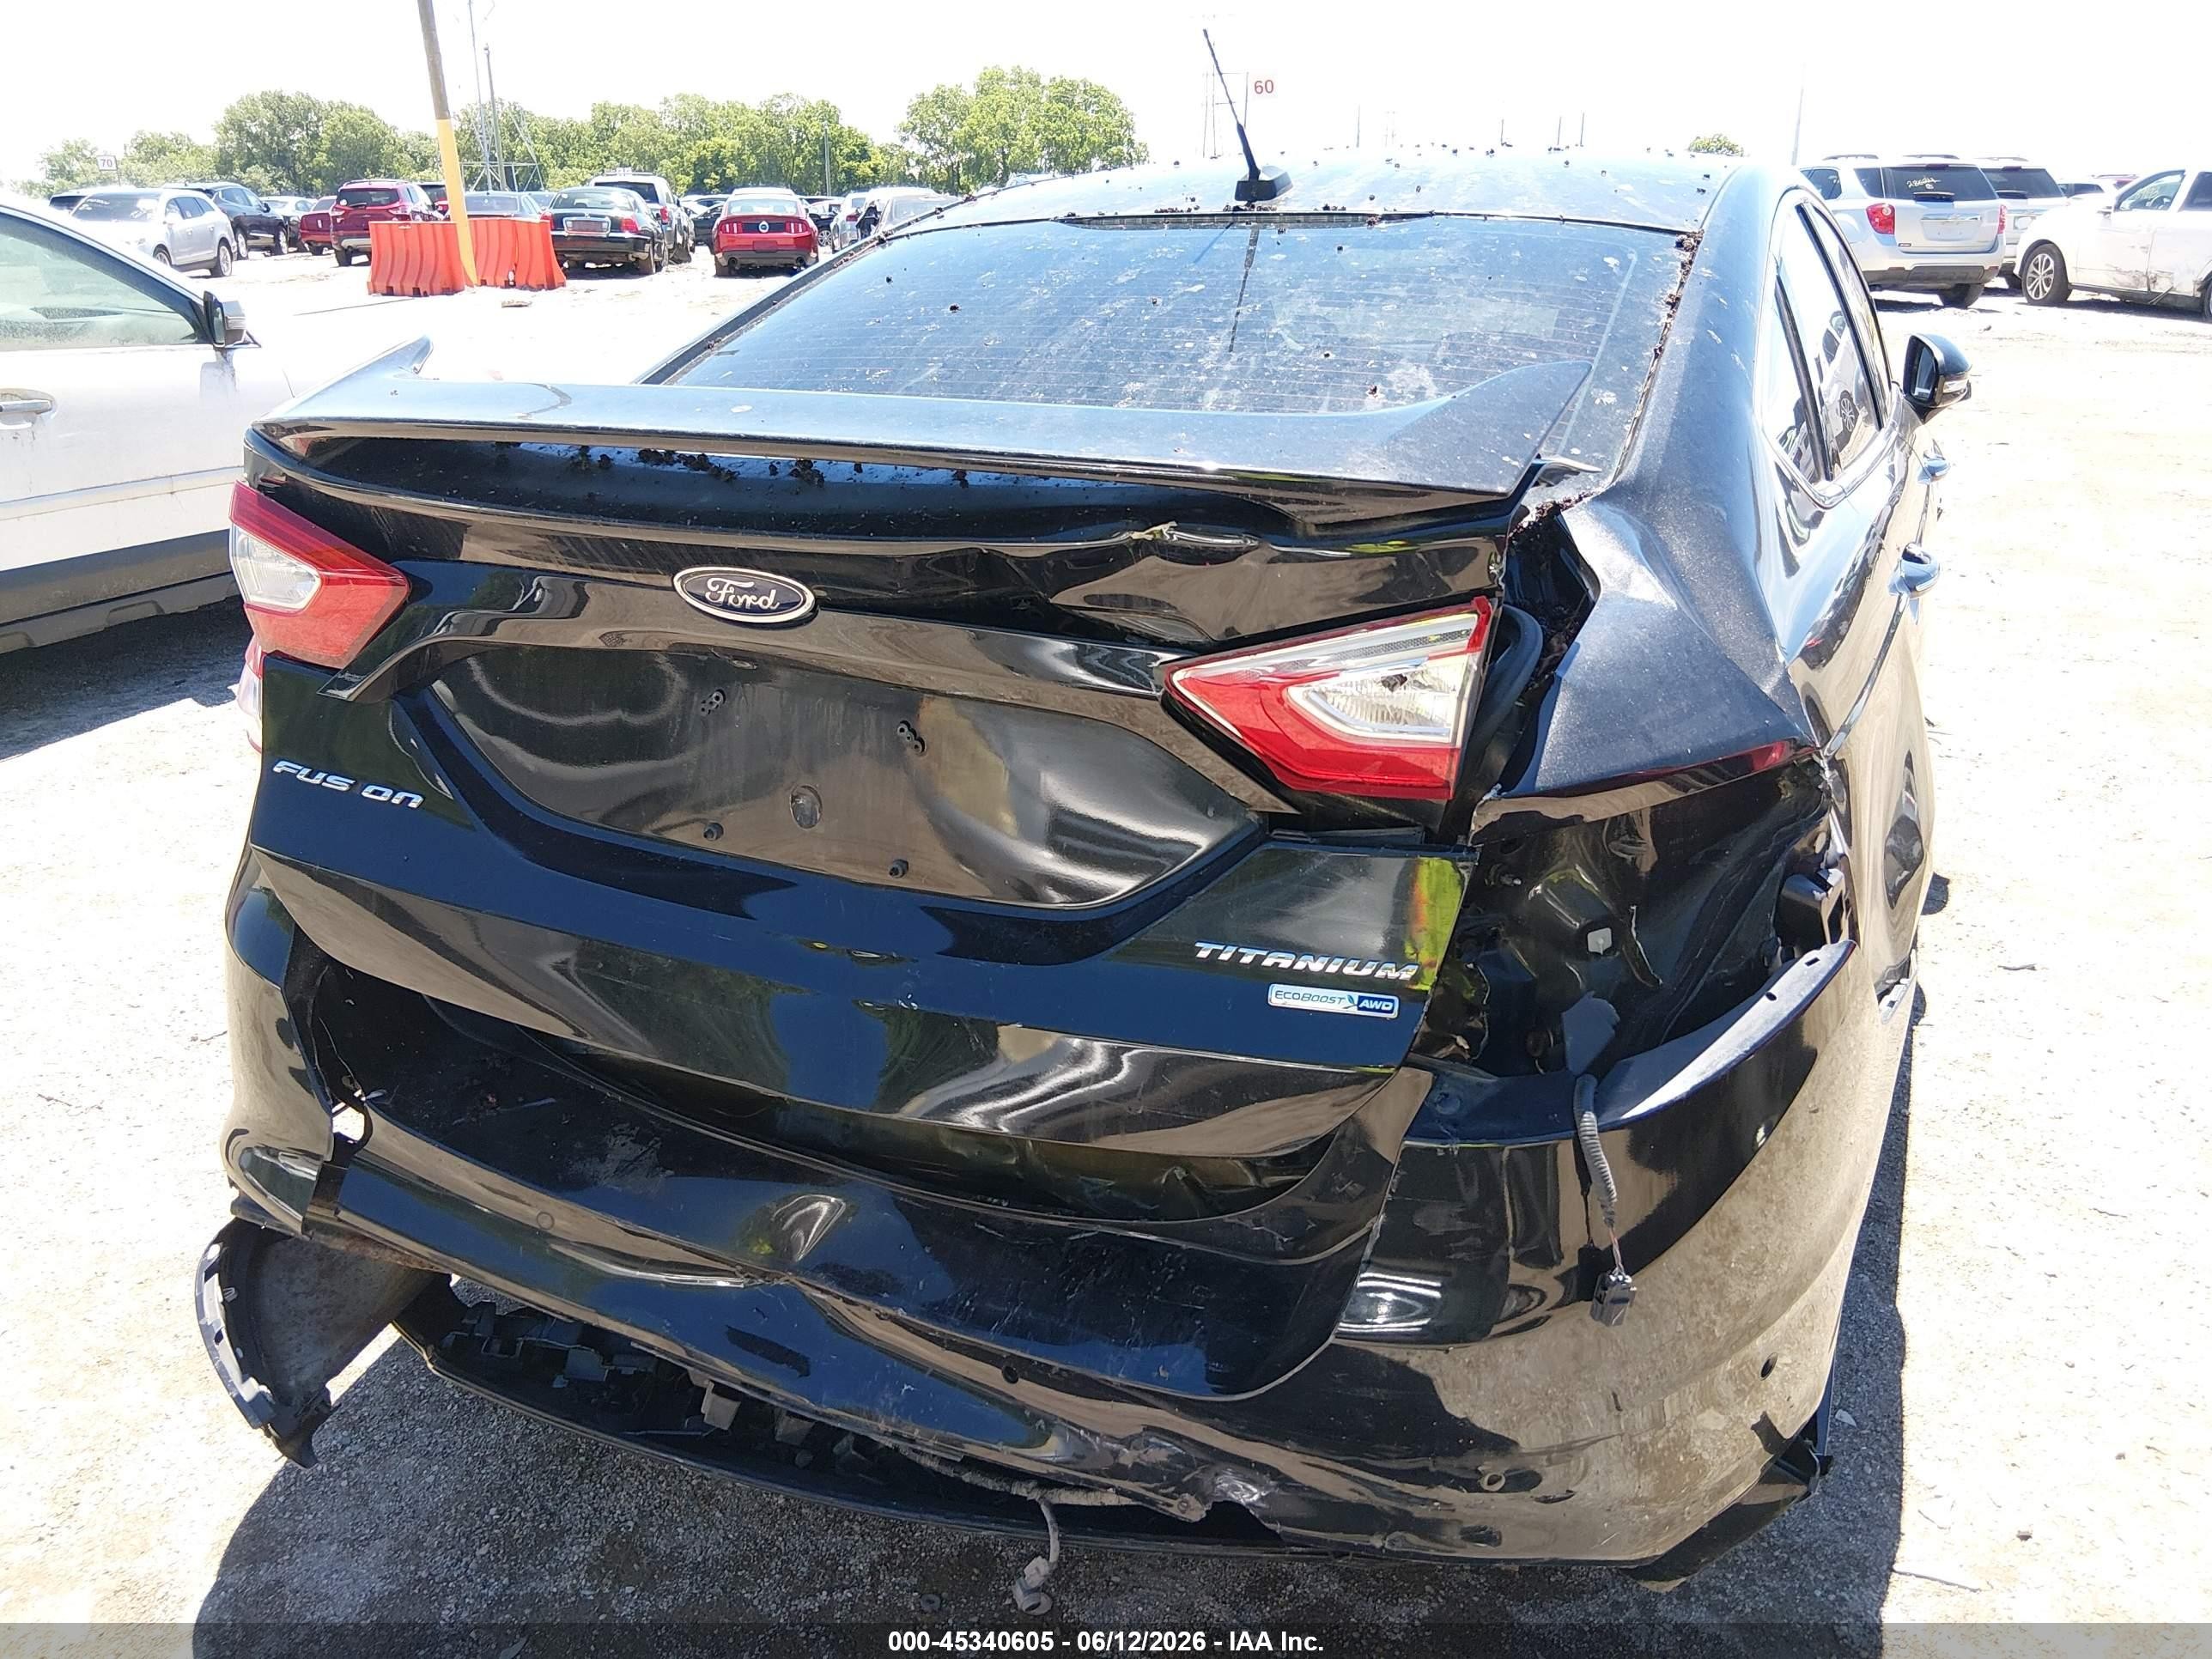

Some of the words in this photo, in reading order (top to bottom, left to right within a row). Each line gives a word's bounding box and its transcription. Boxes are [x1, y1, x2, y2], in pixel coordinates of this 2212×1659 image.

[1254, 79, 1274, 94] 60
[100, 159, 113, 168] 70
[704, 577, 780, 610] Ford
[1195, 941, 1419, 981] TITANIUM
[1358, 999, 1394, 1011] AWD
